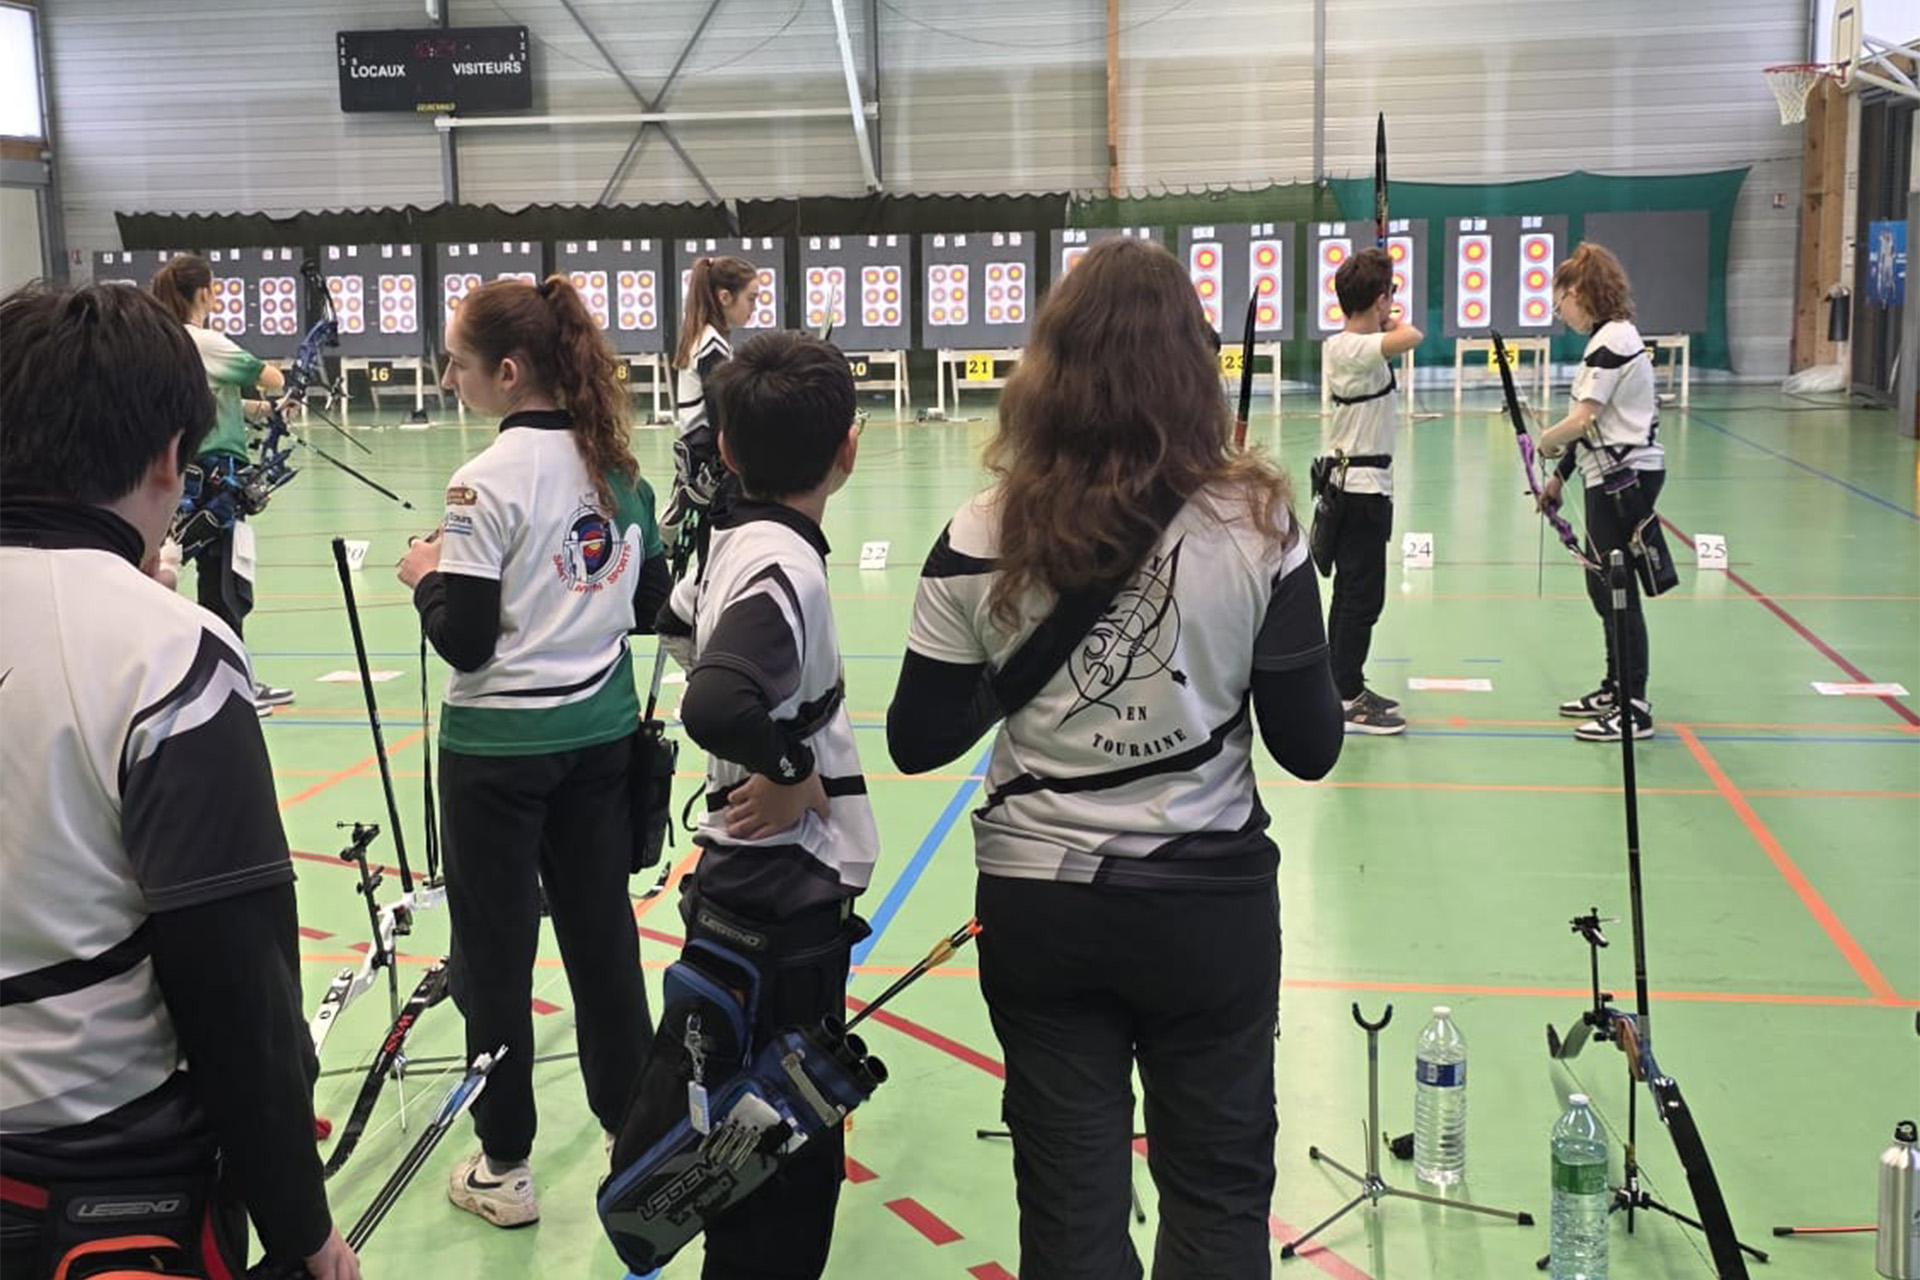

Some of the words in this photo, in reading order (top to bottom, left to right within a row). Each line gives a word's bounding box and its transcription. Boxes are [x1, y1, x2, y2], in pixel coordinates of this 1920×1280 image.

[350, 64, 406, 79] LOCAUX
[452, 60, 522, 75] VISITEURS
[371, 366, 389, 381] 16
[969, 359, 987, 374] 21
[862, 546, 886, 561] 22
[1405, 541, 1432, 558] 24
[1699, 541, 1727, 559] 25
[1126, 706, 1148, 721] EN
[1092, 728, 1188, 757] TOURAINE
[639, 1155, 719, 1221] LEGEN
[77, 1199, 180, 1217] LEGEND
